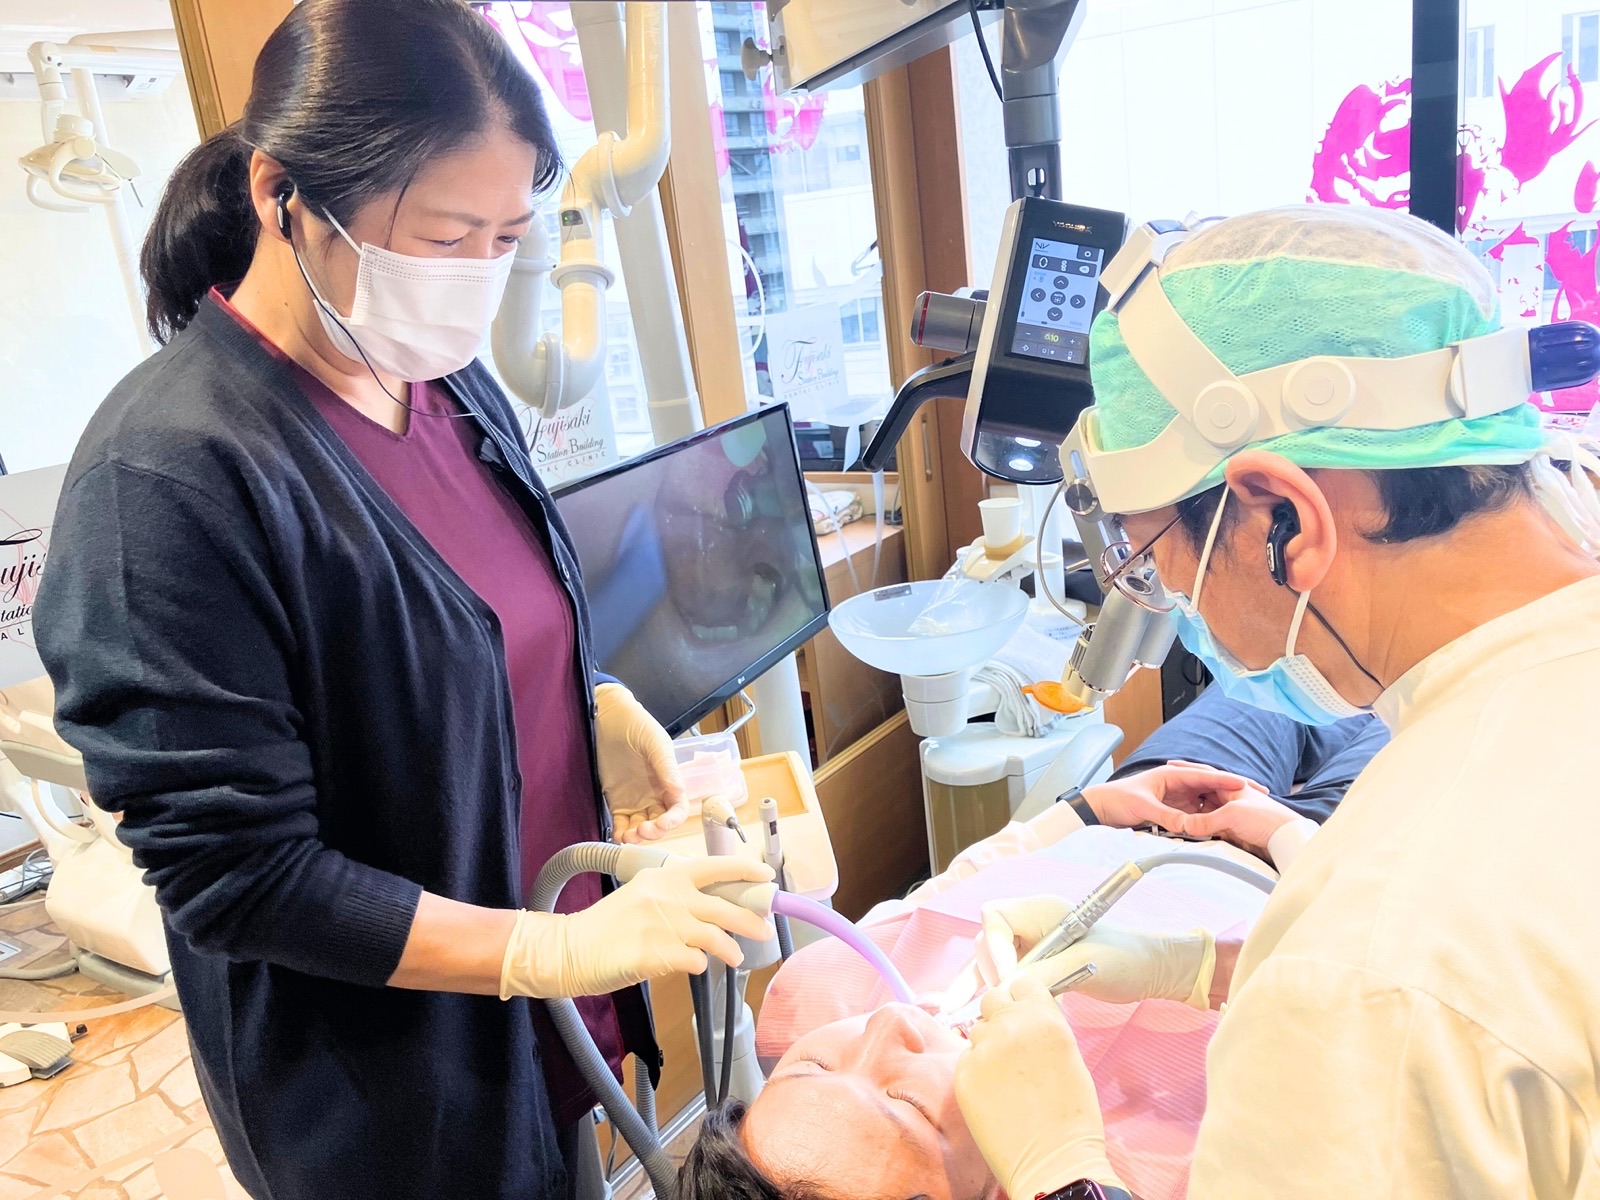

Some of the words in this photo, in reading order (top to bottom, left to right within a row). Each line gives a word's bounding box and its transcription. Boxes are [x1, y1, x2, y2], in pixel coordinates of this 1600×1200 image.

[536, 444, 569, 462] Station
[569, 437, 604, 454] Building
[567, 452, 606, 466] CLINIC
[0, 603, 33, 622] tatio
